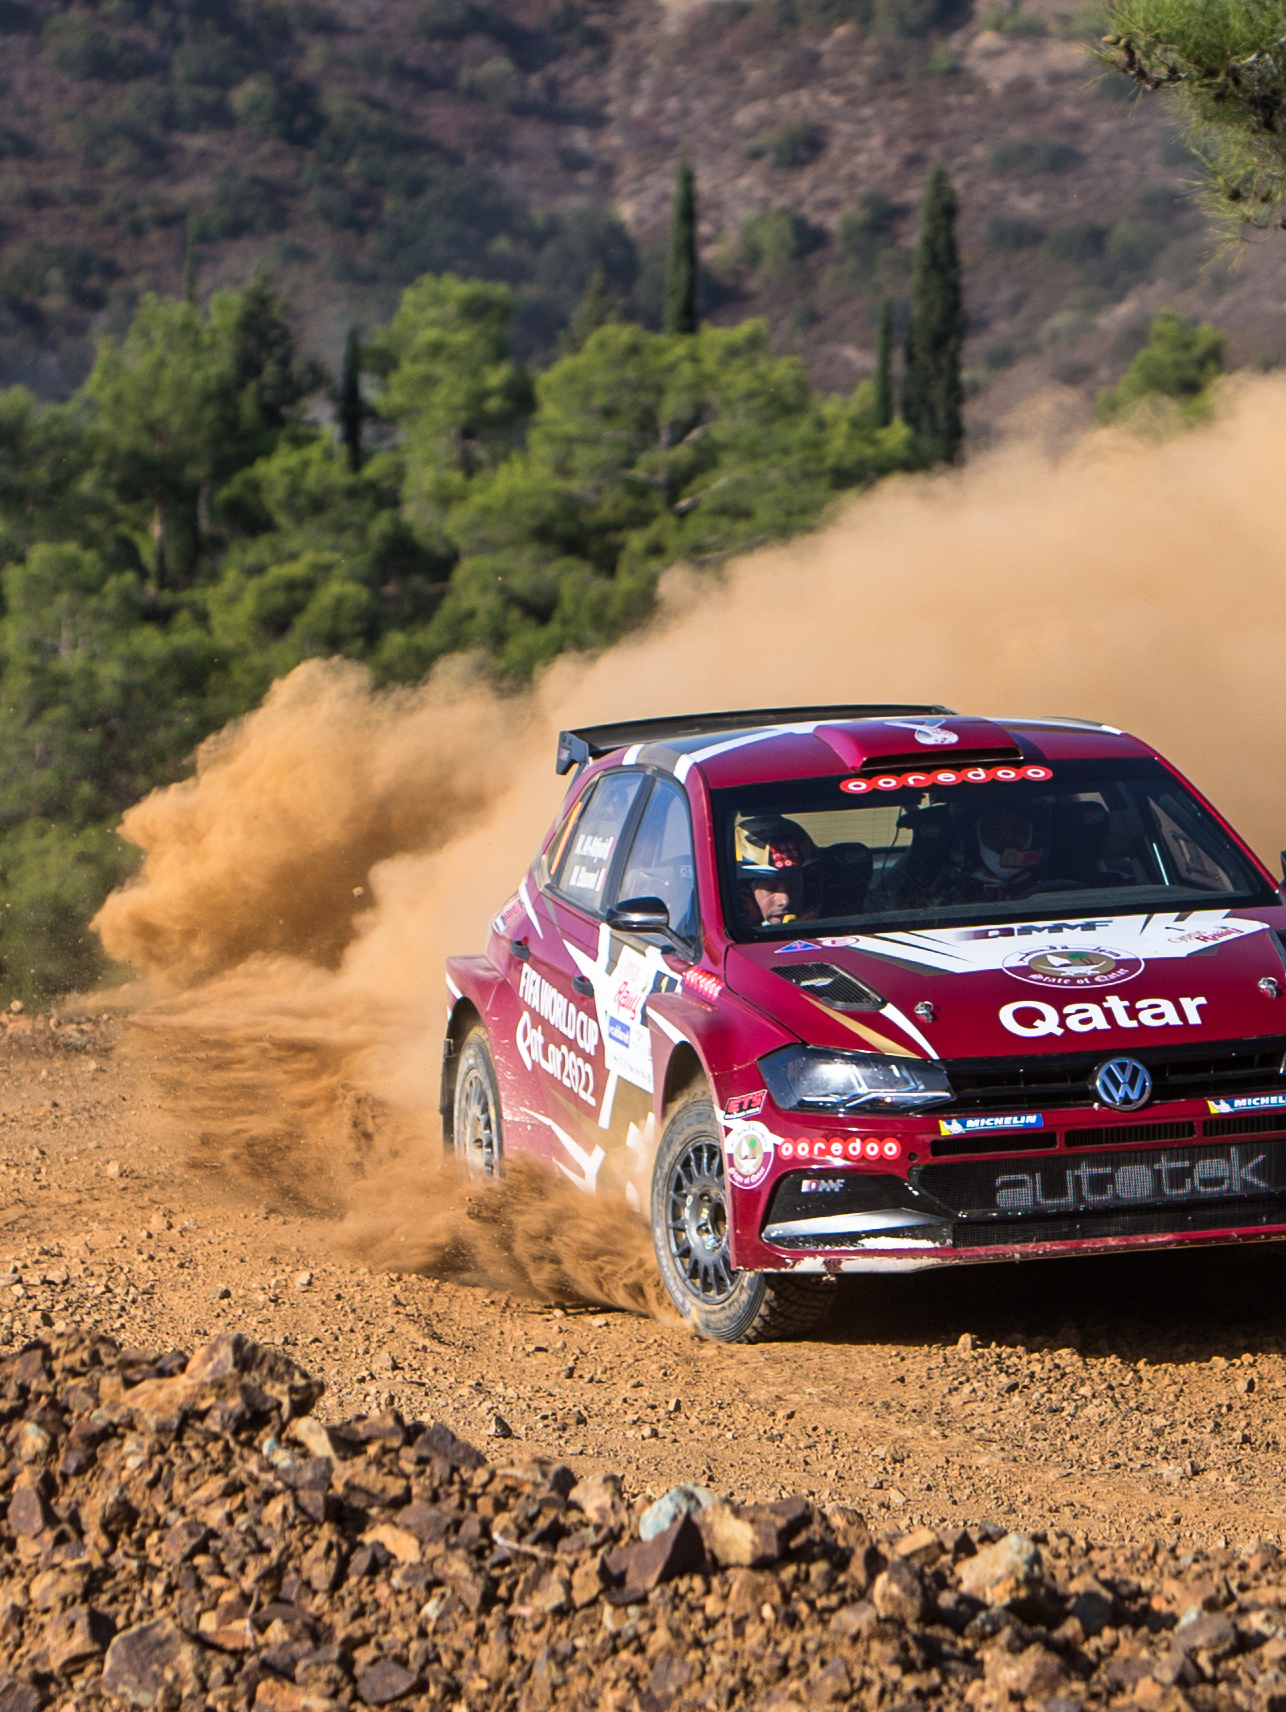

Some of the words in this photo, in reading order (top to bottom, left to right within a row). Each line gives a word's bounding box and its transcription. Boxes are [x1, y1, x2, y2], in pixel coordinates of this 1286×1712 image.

[846, 766, 1047, 791] ooredoo
[519, 962, 542, 1013] FIFA
[540, 978, 577, 1040] WORLD
[576, 1010, 599, 1056] CUP
[998, 995, 1208, 1038] Qatar
[966, 1114, 1037, 1128] MICHELIN
[780, 1137, 898, 1157] ooredoo
[995, 1146, 1268, 1207] autotek
